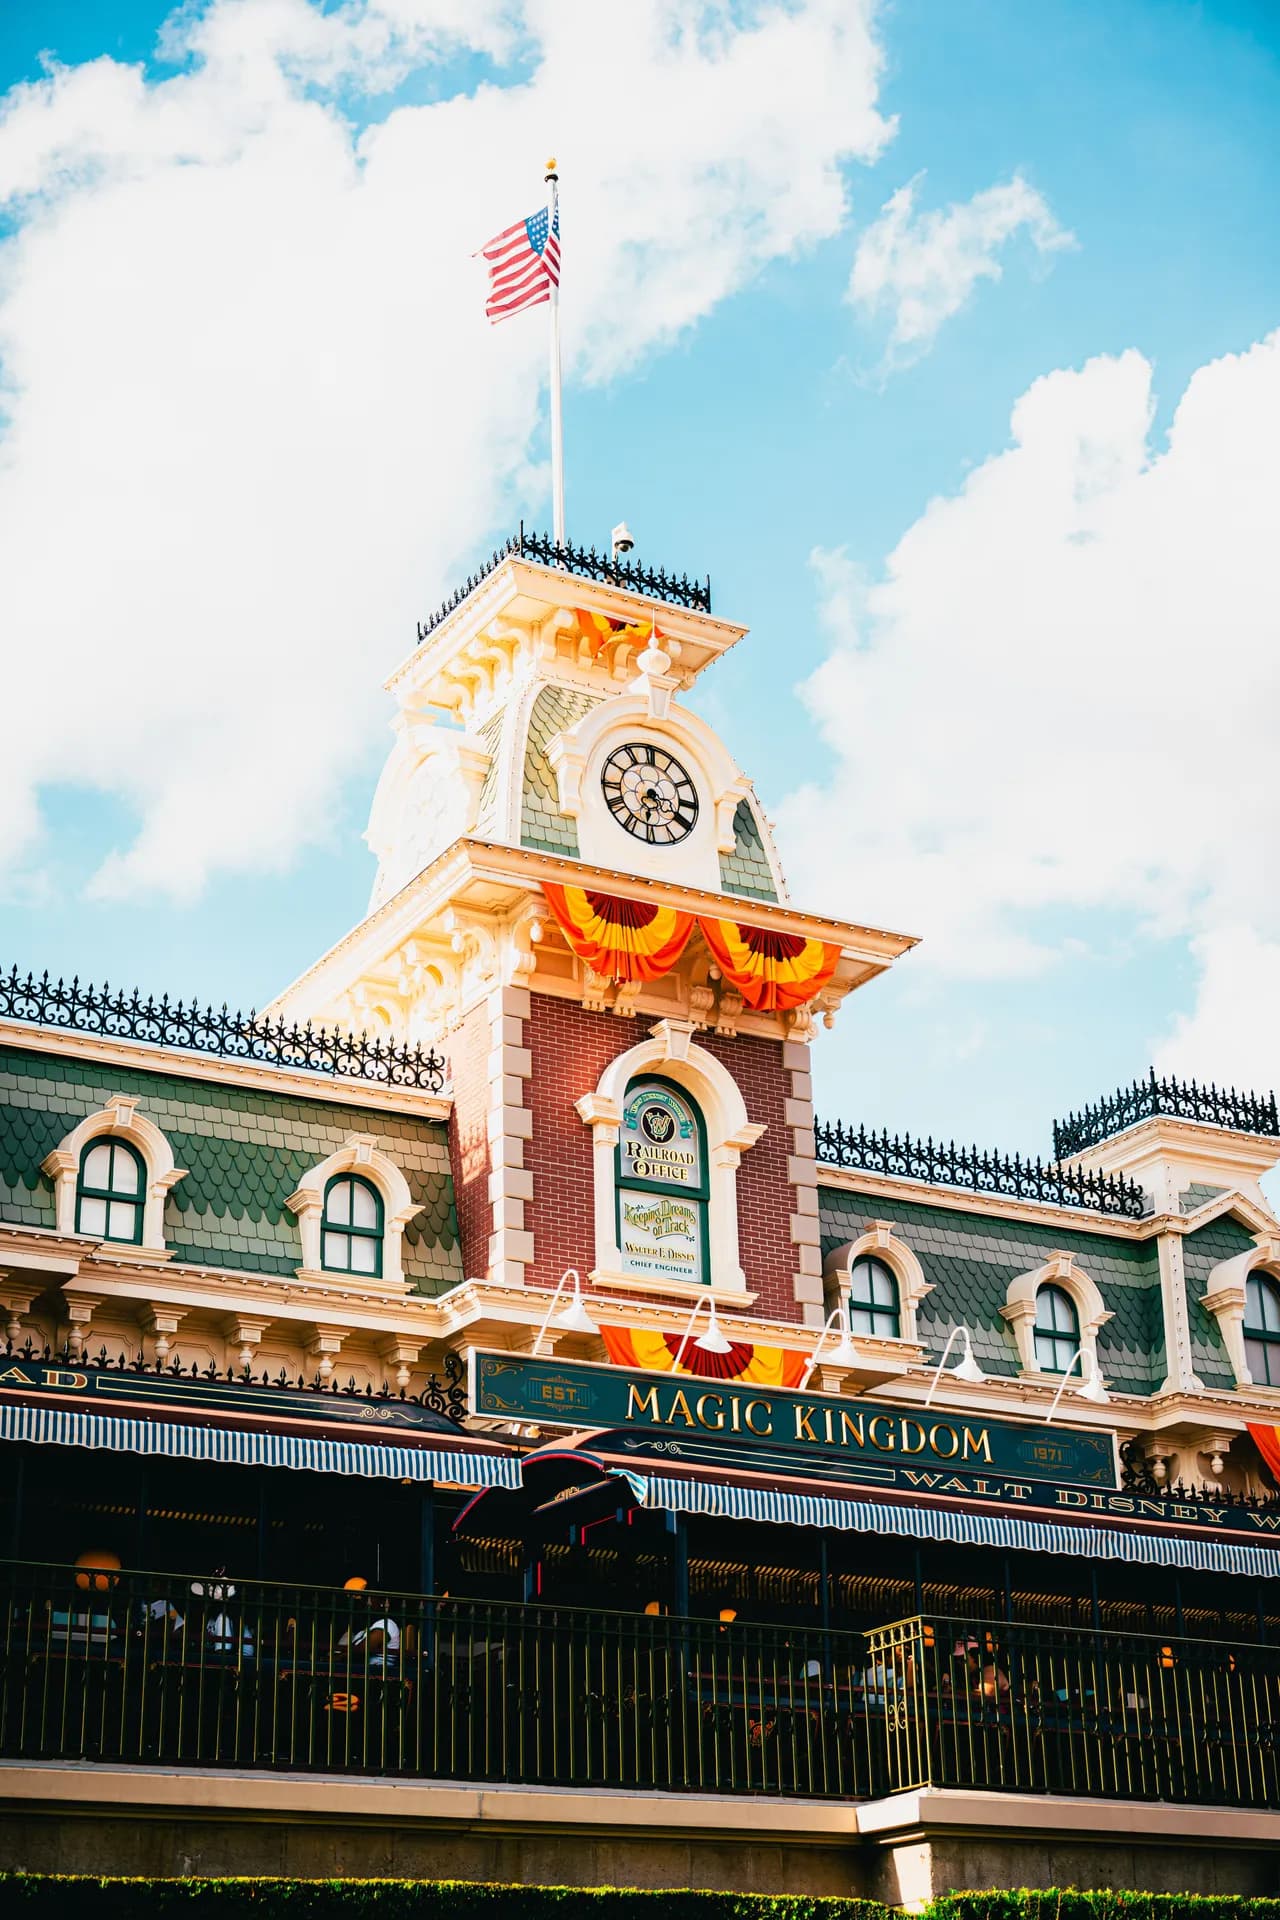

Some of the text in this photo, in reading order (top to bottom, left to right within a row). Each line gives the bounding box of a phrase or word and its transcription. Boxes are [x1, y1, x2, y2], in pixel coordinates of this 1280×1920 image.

[625, 1140, 695, 1165] RAILROAD
[632, 1159, 688, 1181] OFFICE
[624, 1200, 697, 1231] Keeping Dreams
[653, 1217, 690, 1236] on Track
[630, 1260, 693, 1274] CHIEF ENGINEER
[542, 1385, 581, 1402] EST.
[625, 1383, 995, 1464] MAGIC KINGDOM
[1033, 1446, 1063, 1461] 1971
[900, 1469, 1032, 1499] WALT
[1055, 1489, 1228, 1523] DISNEY
